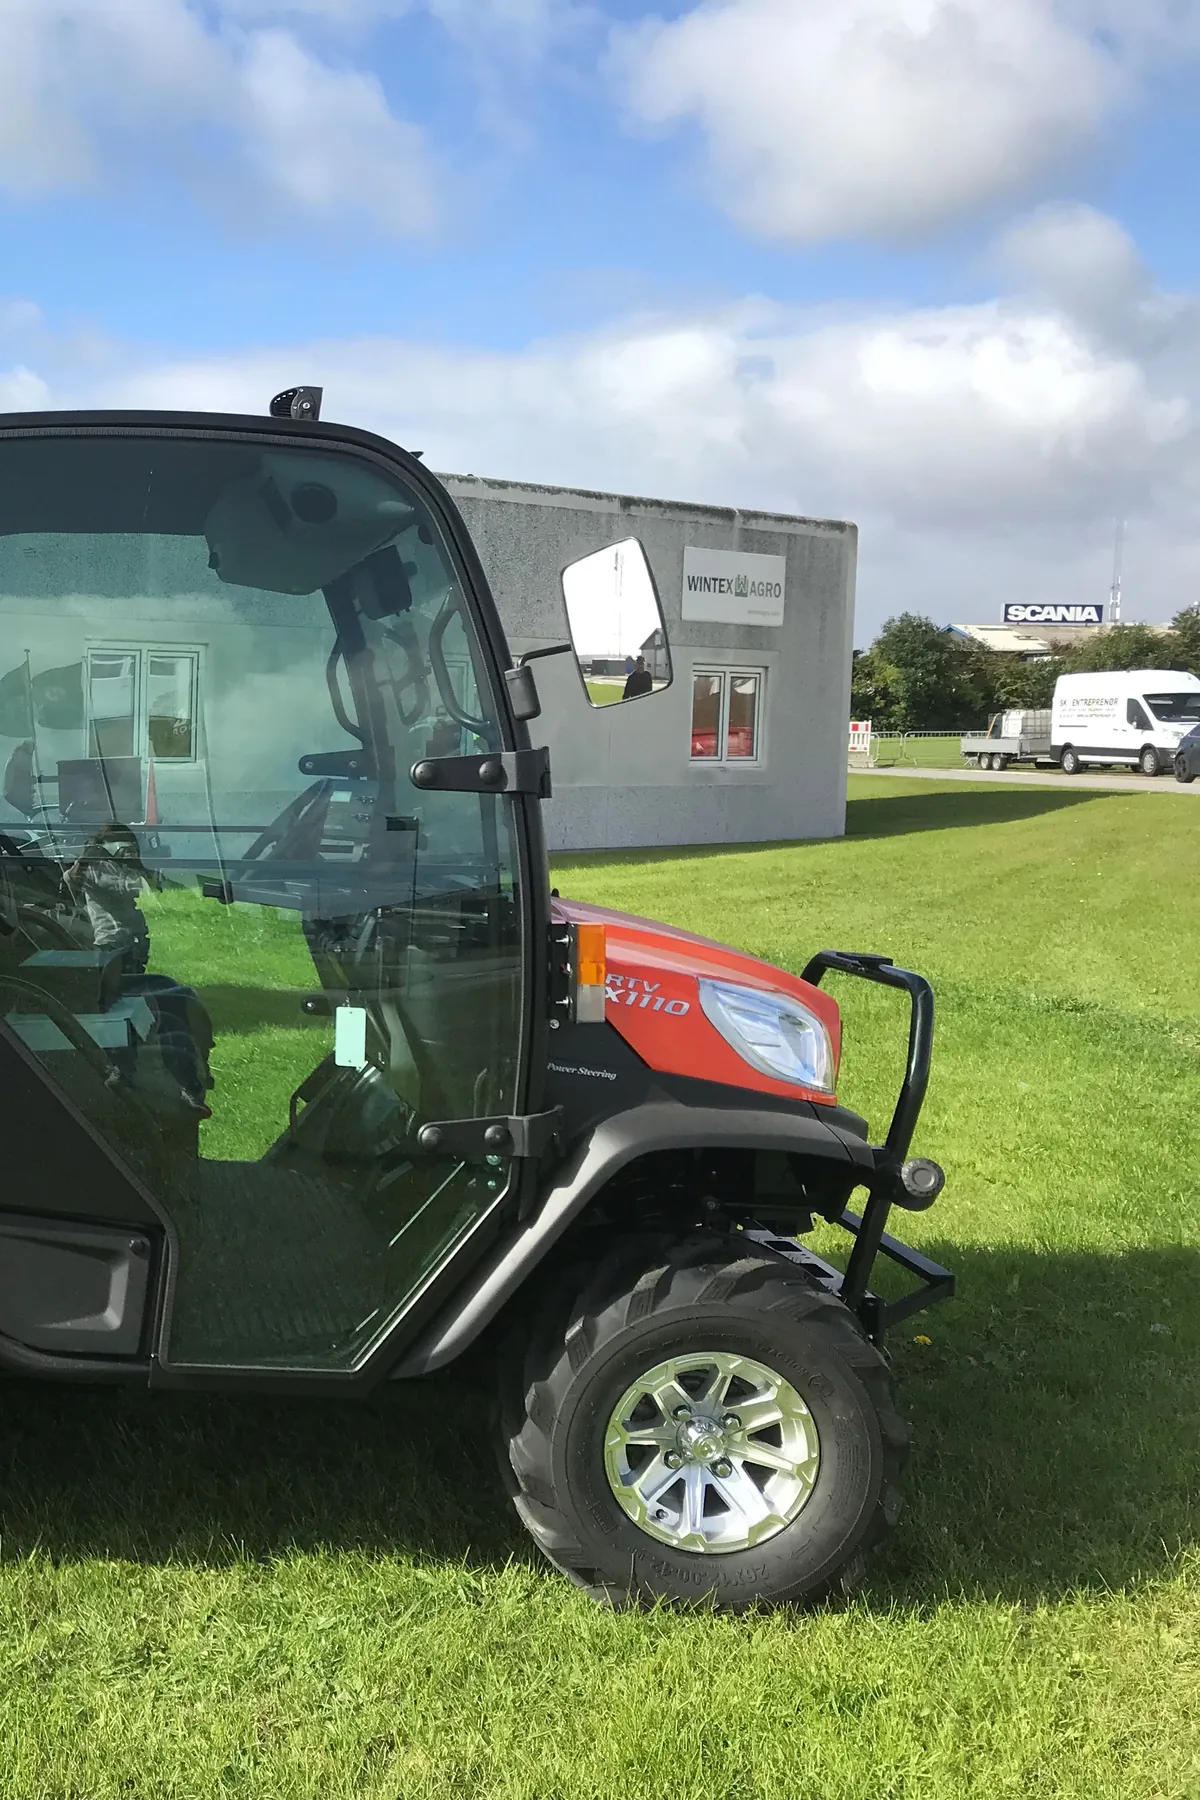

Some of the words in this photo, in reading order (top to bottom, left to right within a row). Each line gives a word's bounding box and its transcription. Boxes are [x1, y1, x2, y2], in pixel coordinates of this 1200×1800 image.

[687, 575, 734, 595] WINTEX
[749, 581, 782, 598] AGRO
[1006, 605, 1100, 622] SCANIA
[605, 973, 661, 993] RTV
[605, 986, 691, 1016] X1110
[547, 1062, 577, 1075] Power
[577, 1066, 617, 1081] Steering
